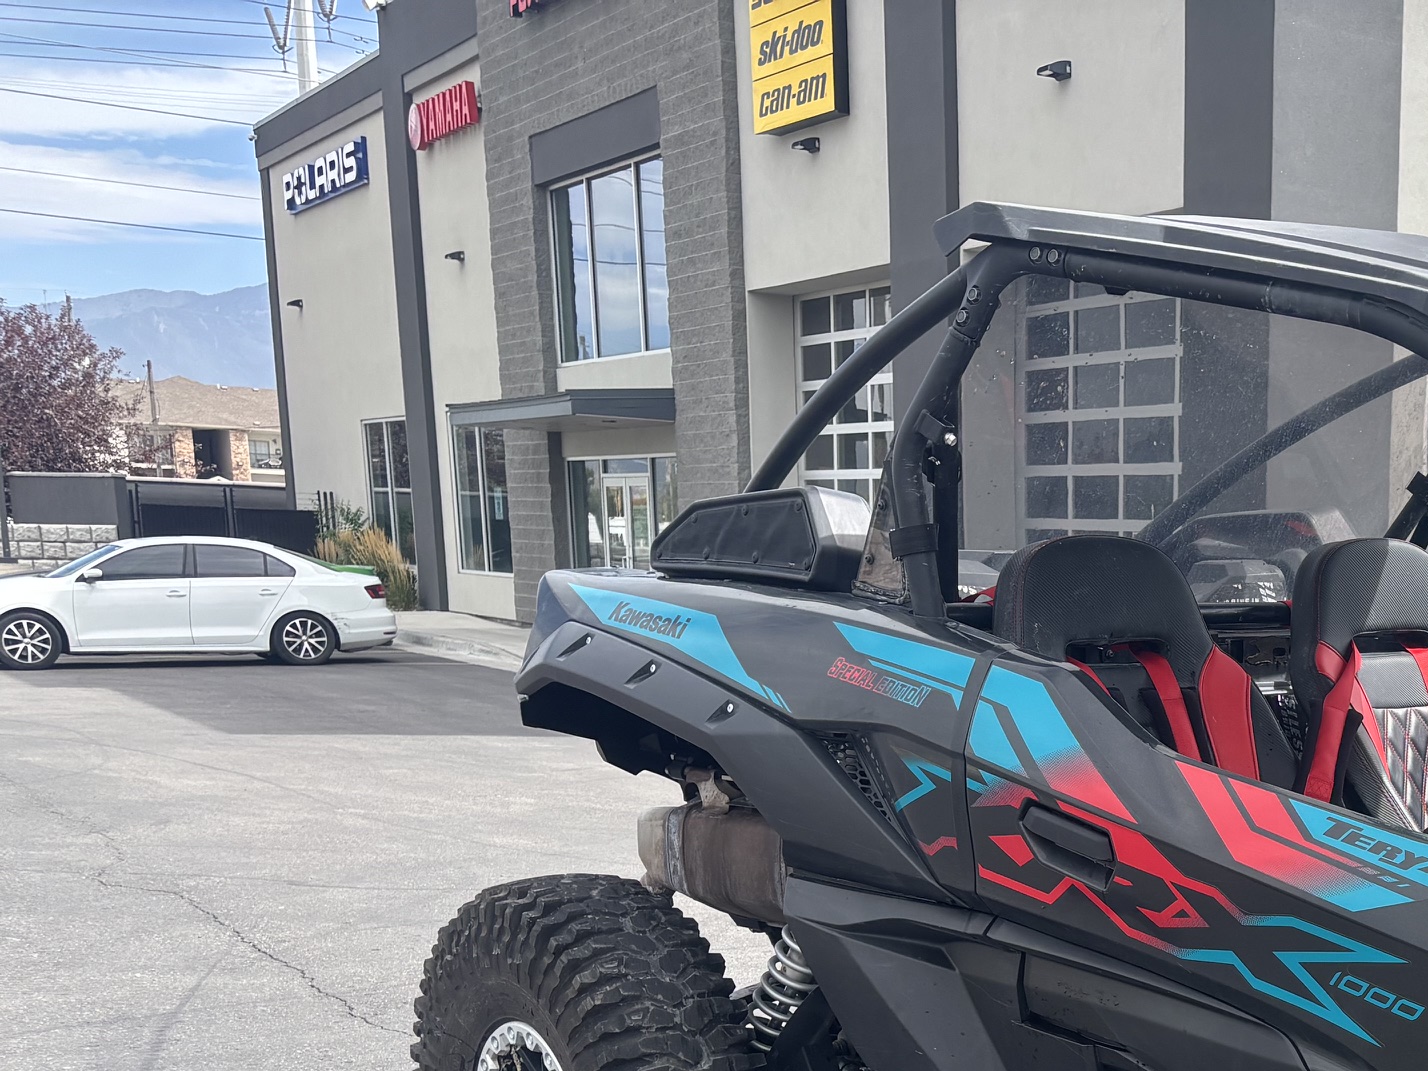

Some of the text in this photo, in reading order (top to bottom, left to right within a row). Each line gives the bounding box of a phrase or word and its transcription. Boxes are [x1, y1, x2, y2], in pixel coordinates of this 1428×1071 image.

[757, 20, 824, 67] ski-doo
[420, 81, 471, 143] YAMAHA
[758, 72, 828, 119] can-am
[282, 141, 358, 211] POLARIS
[607, 600, 692, 640] Kawasaki
[827, 656, 932, 709] SPECIAL EDITION
[1329, 971, 1426, 1022] 1000
